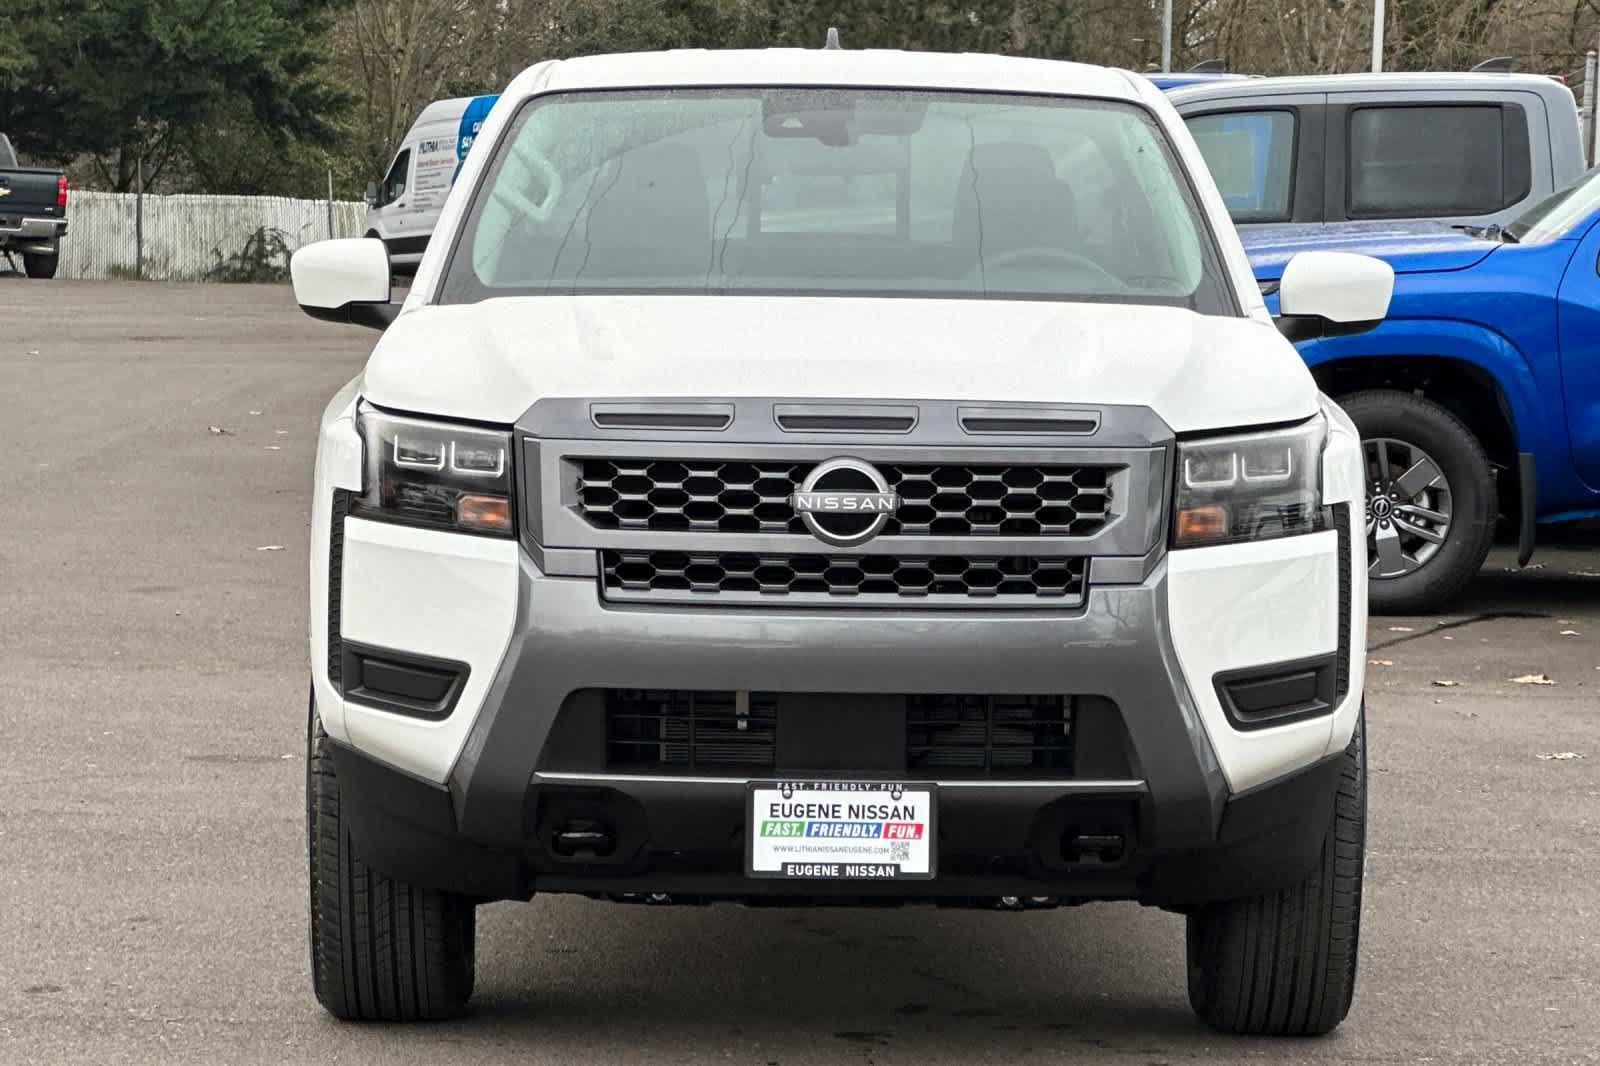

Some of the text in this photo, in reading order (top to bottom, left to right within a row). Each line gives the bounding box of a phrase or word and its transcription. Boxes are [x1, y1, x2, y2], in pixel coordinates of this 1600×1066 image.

[797, 497, 893, 510] NISSAN
[769, 803, 915, 820] EUGENE NISSAN
[765, 822, 920, 840] FAST. FRIENDLY. FUN.
[787, 865, 895, 877] EUGENE NISSAN
